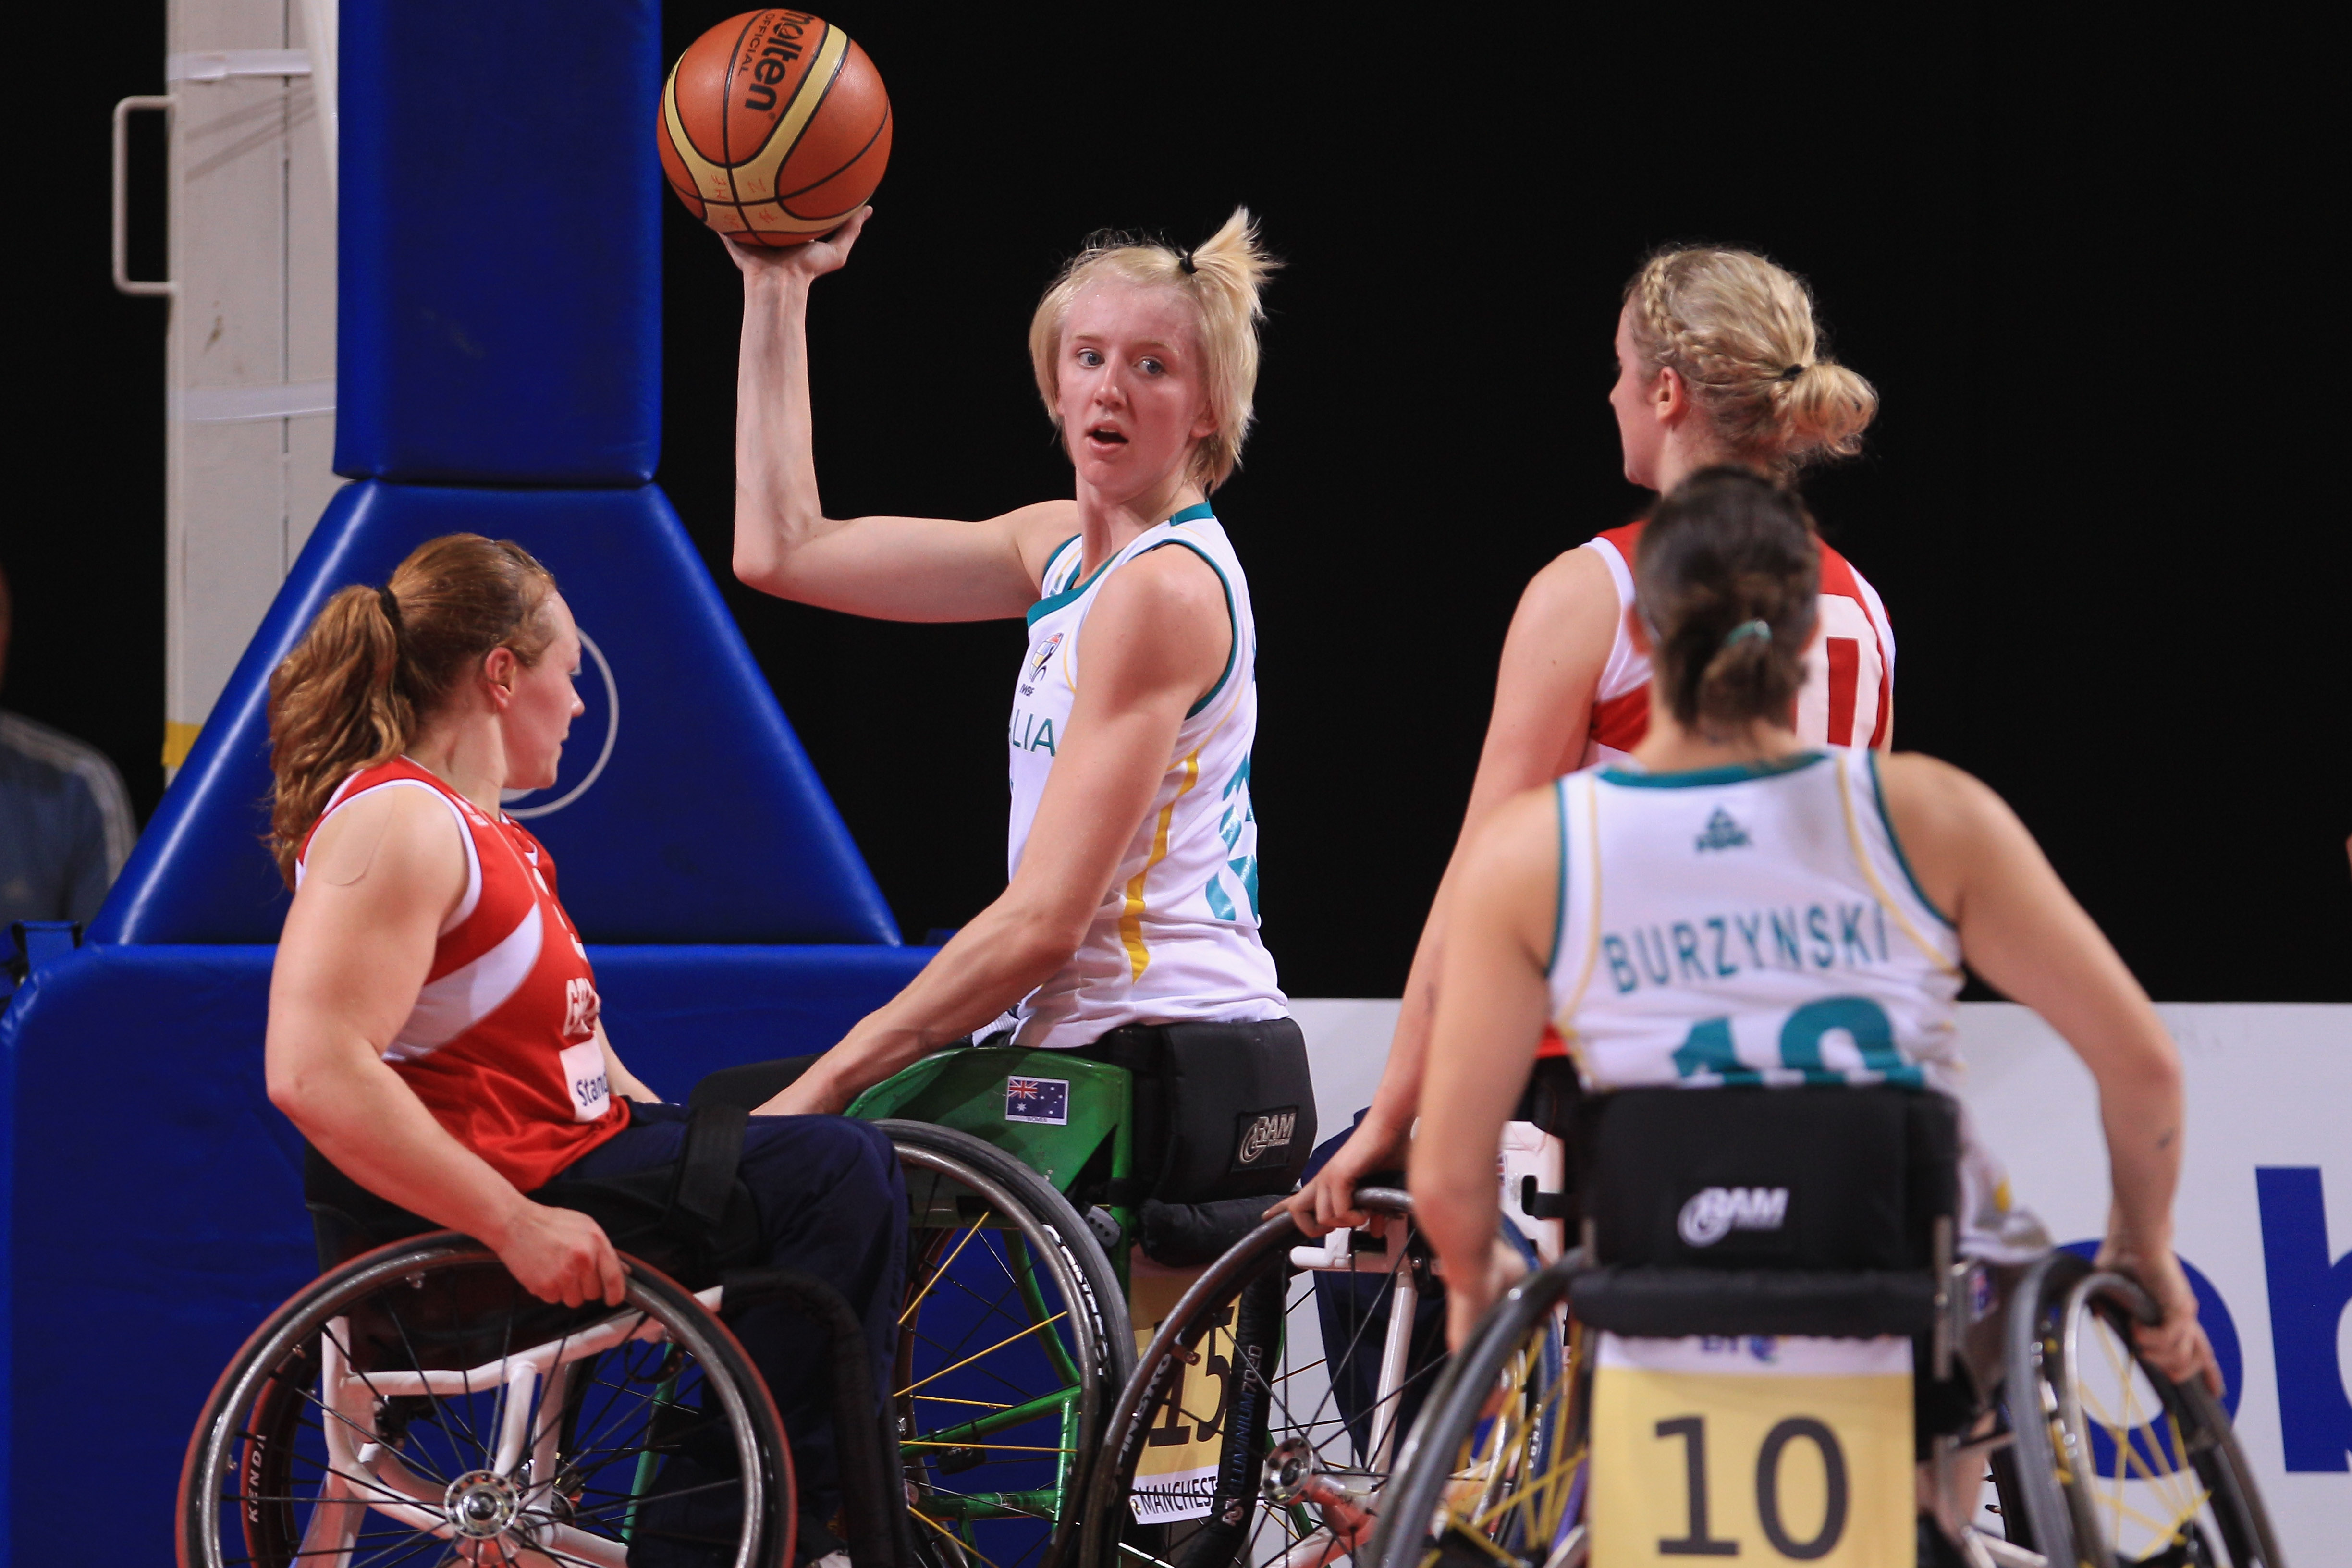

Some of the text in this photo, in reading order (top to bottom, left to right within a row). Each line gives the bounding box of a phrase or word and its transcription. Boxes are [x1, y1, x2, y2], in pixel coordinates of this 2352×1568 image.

[738, 13, 775, 76] OFFICIAL
[745, 9, 816, 111] molten
[1009, 709, 1055, 757] LIA
[1604, 902, 1891, 994] BURZYNSKI
[248, 1434, 267, 1523] KENDA
[1139, 1476, 1216, 1515] MANCHEST
[1654, 1415, 1851, 1561] 10
